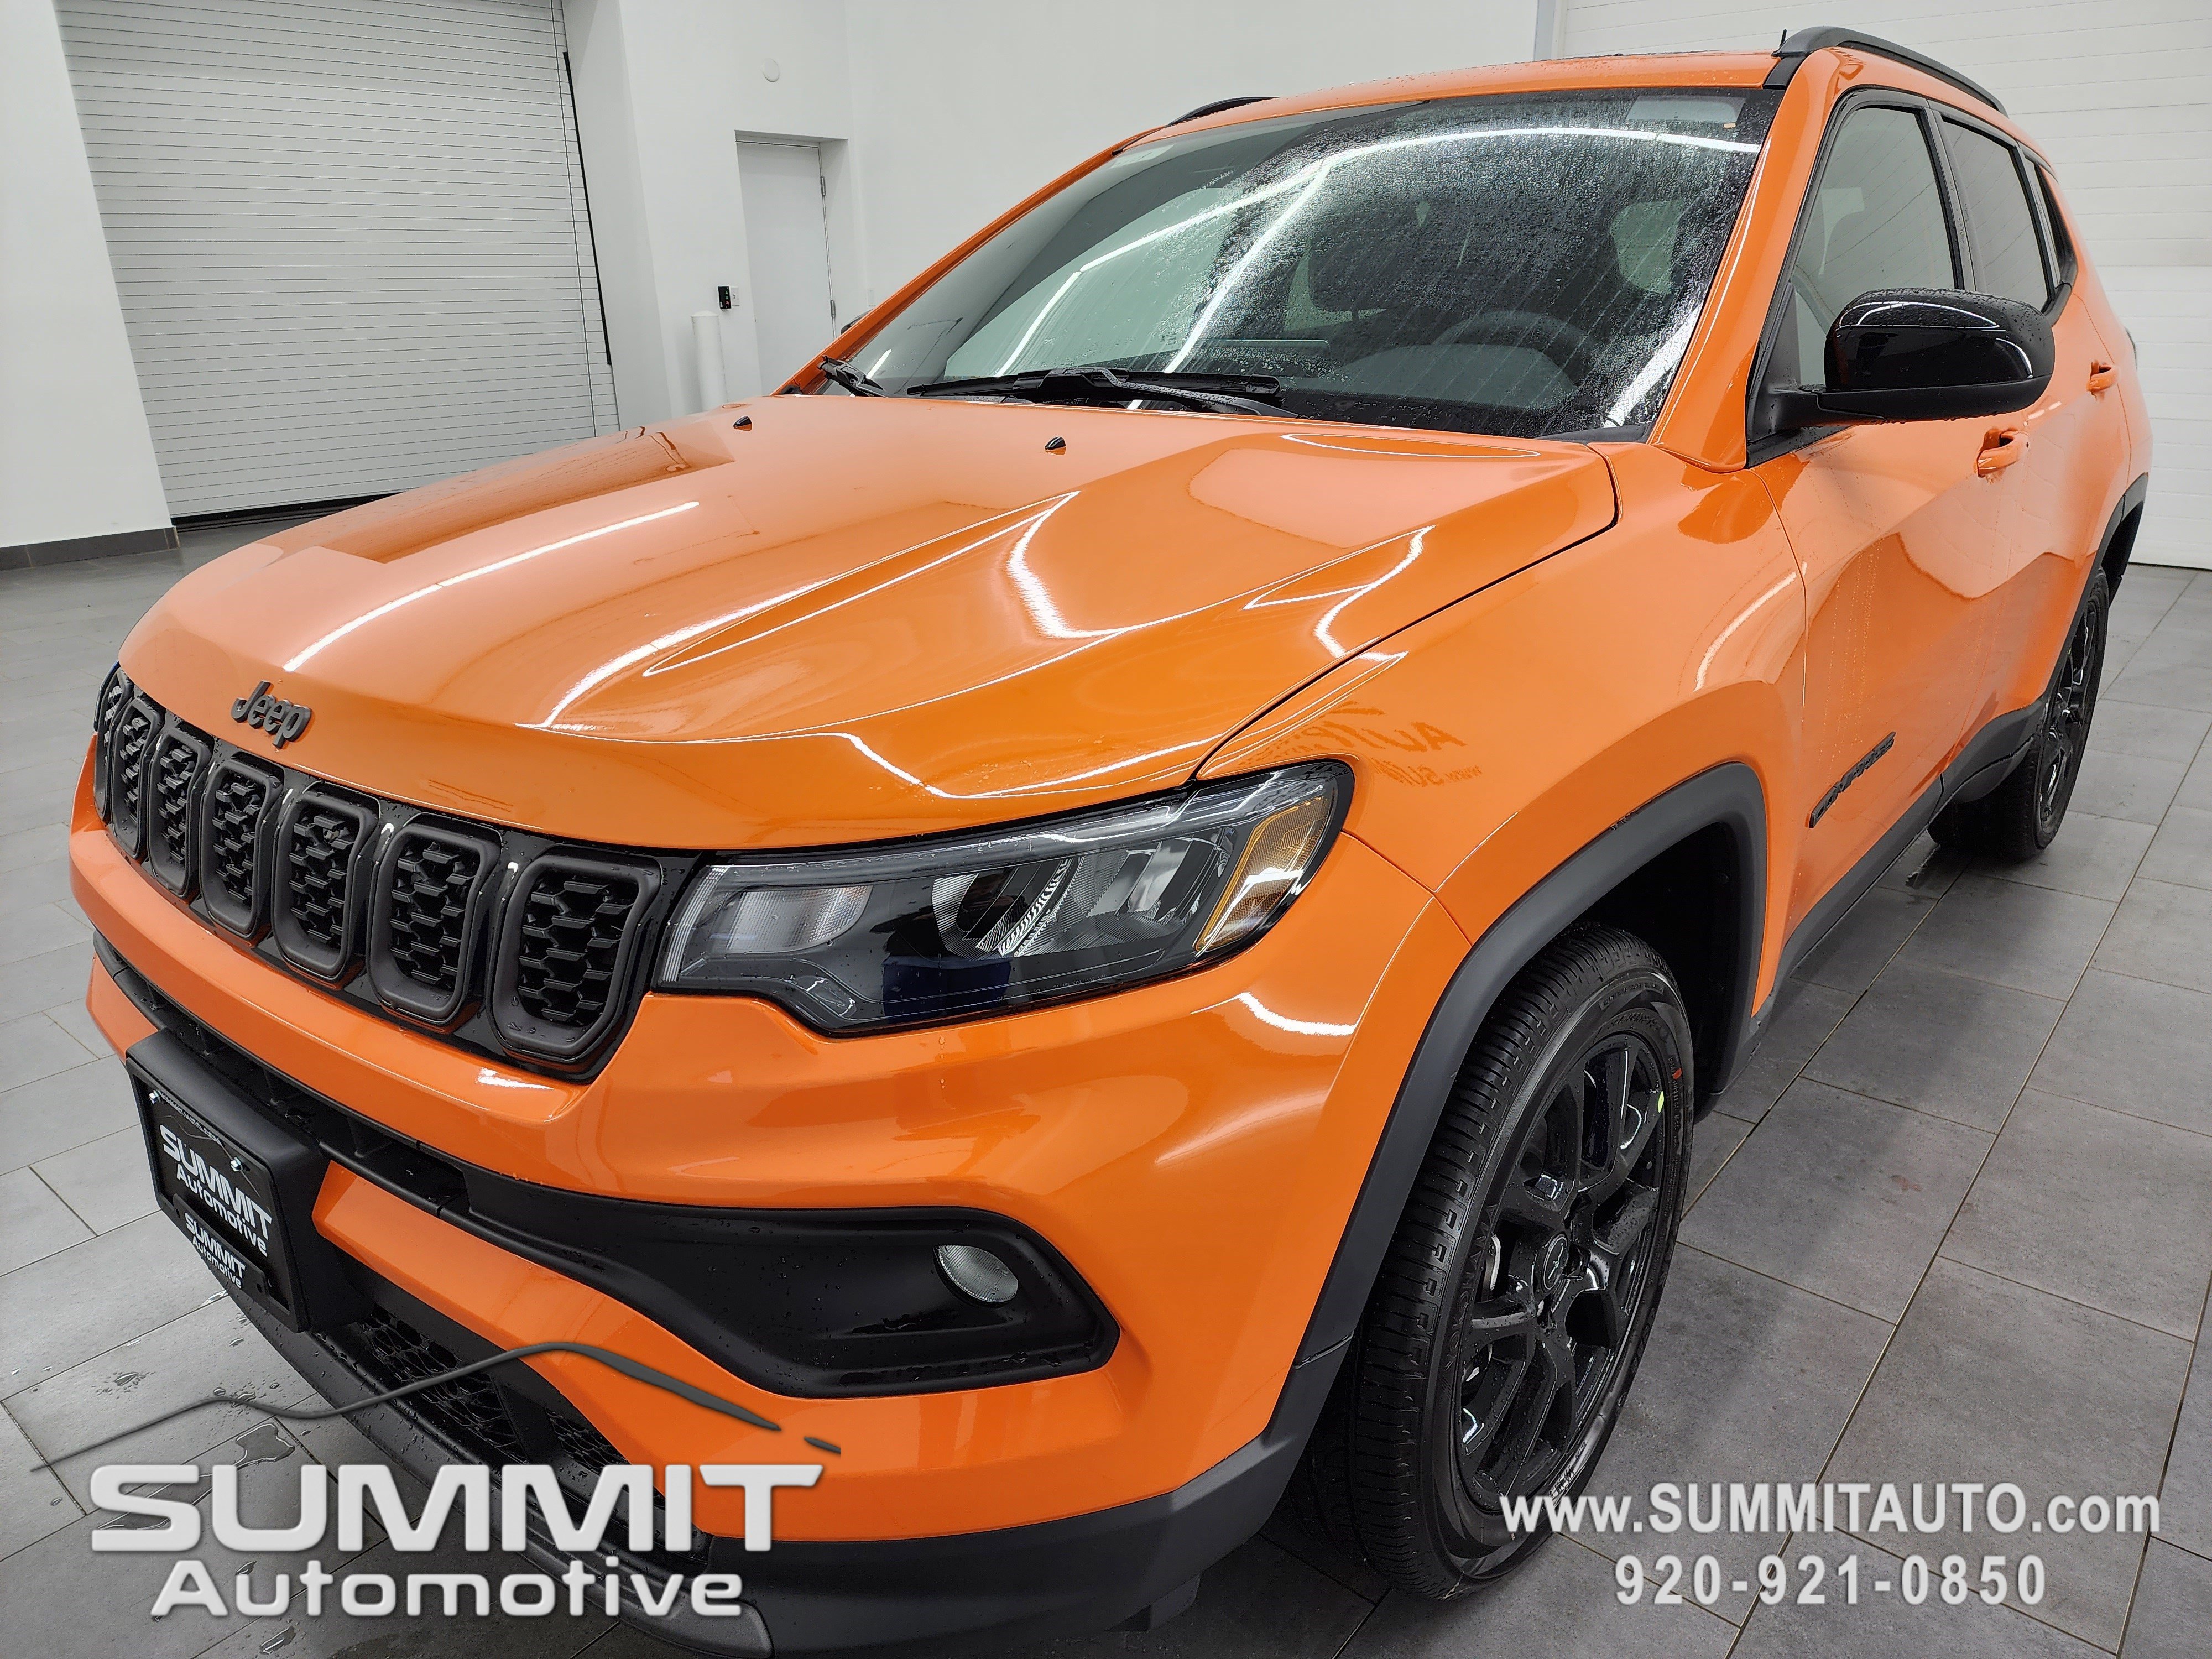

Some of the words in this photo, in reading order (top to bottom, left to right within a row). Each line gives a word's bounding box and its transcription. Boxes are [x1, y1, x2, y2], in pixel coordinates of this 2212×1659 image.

[230, 680, 313, 749] Jeep
[160, 1124, 272, 1240] SUMMIT
[176, 1163, 268, 1258] Automotive
[185, 1212, 246, 1279] SUMMIT
[192, 1235, 242, 1290] Automotive
